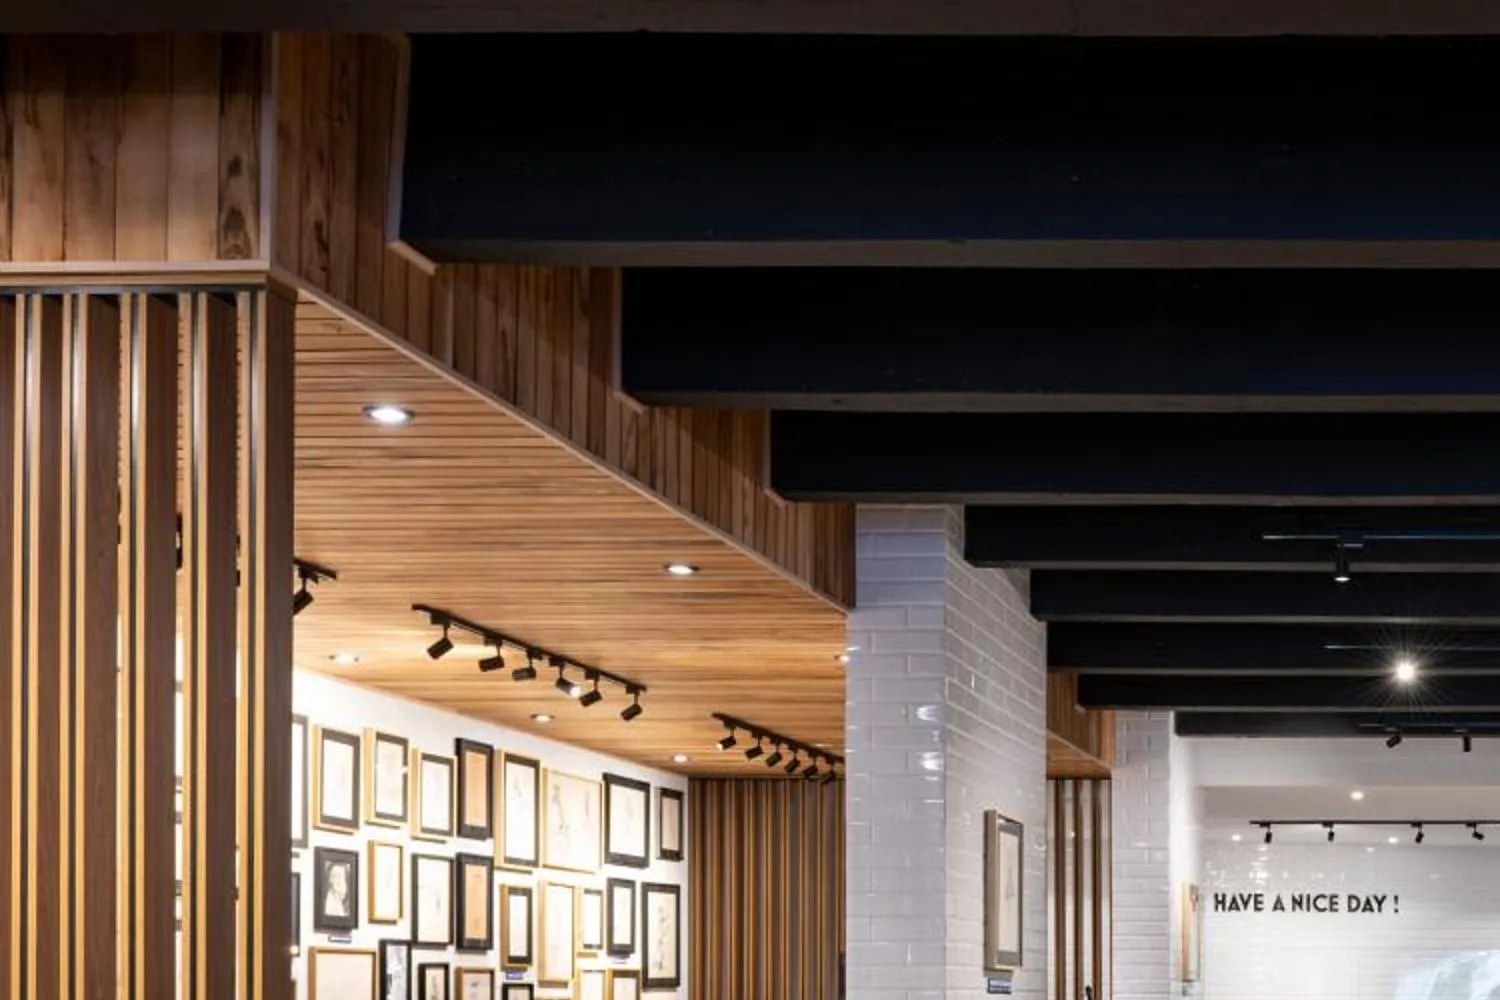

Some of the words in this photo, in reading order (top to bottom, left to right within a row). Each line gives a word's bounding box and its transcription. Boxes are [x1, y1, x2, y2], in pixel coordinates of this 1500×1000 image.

[1213, 892, 1264, 913] HAVE
[1271, 892, 1285, 913] A
[1291, 892, 1339, 913] NICE
